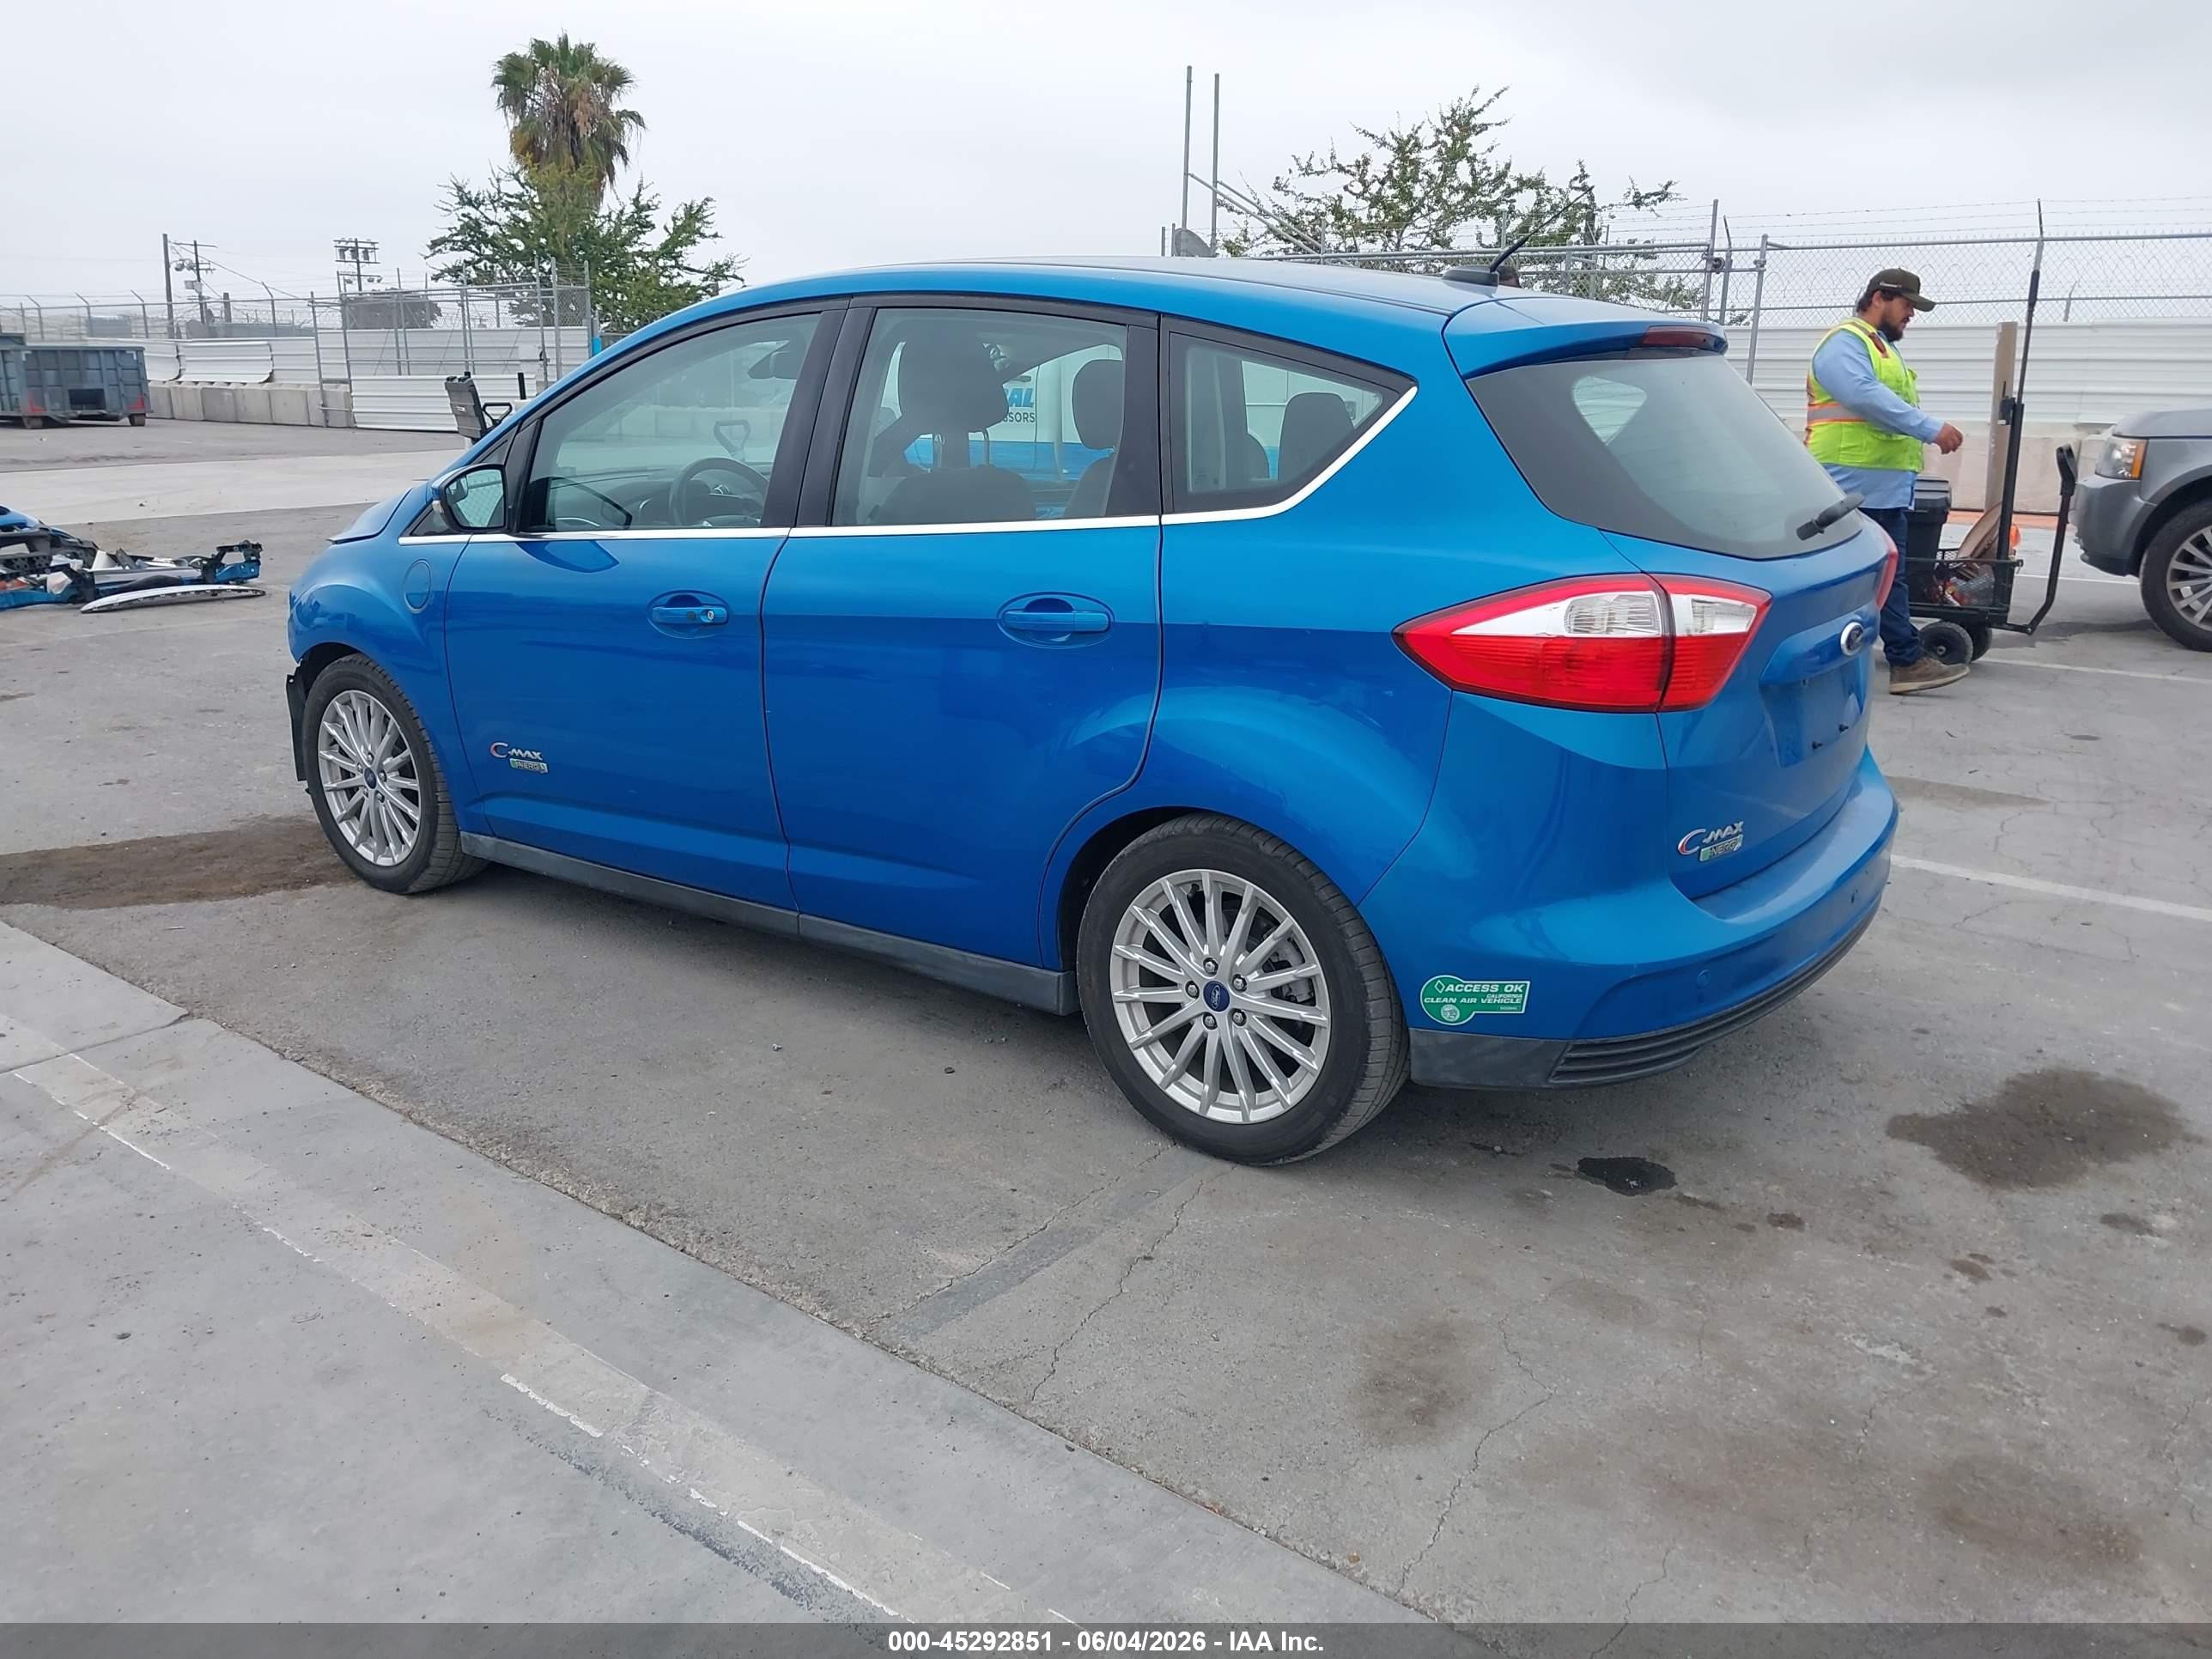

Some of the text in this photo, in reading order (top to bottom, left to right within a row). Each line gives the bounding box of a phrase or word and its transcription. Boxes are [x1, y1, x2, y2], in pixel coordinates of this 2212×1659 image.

[1006, 388, 1033, 408] AL
[490, 742, 543, 761] C-MAX
[1678, 821, 1744, 855] C-MAX
[1445, 984, 1525, 993] ACCESS OK
